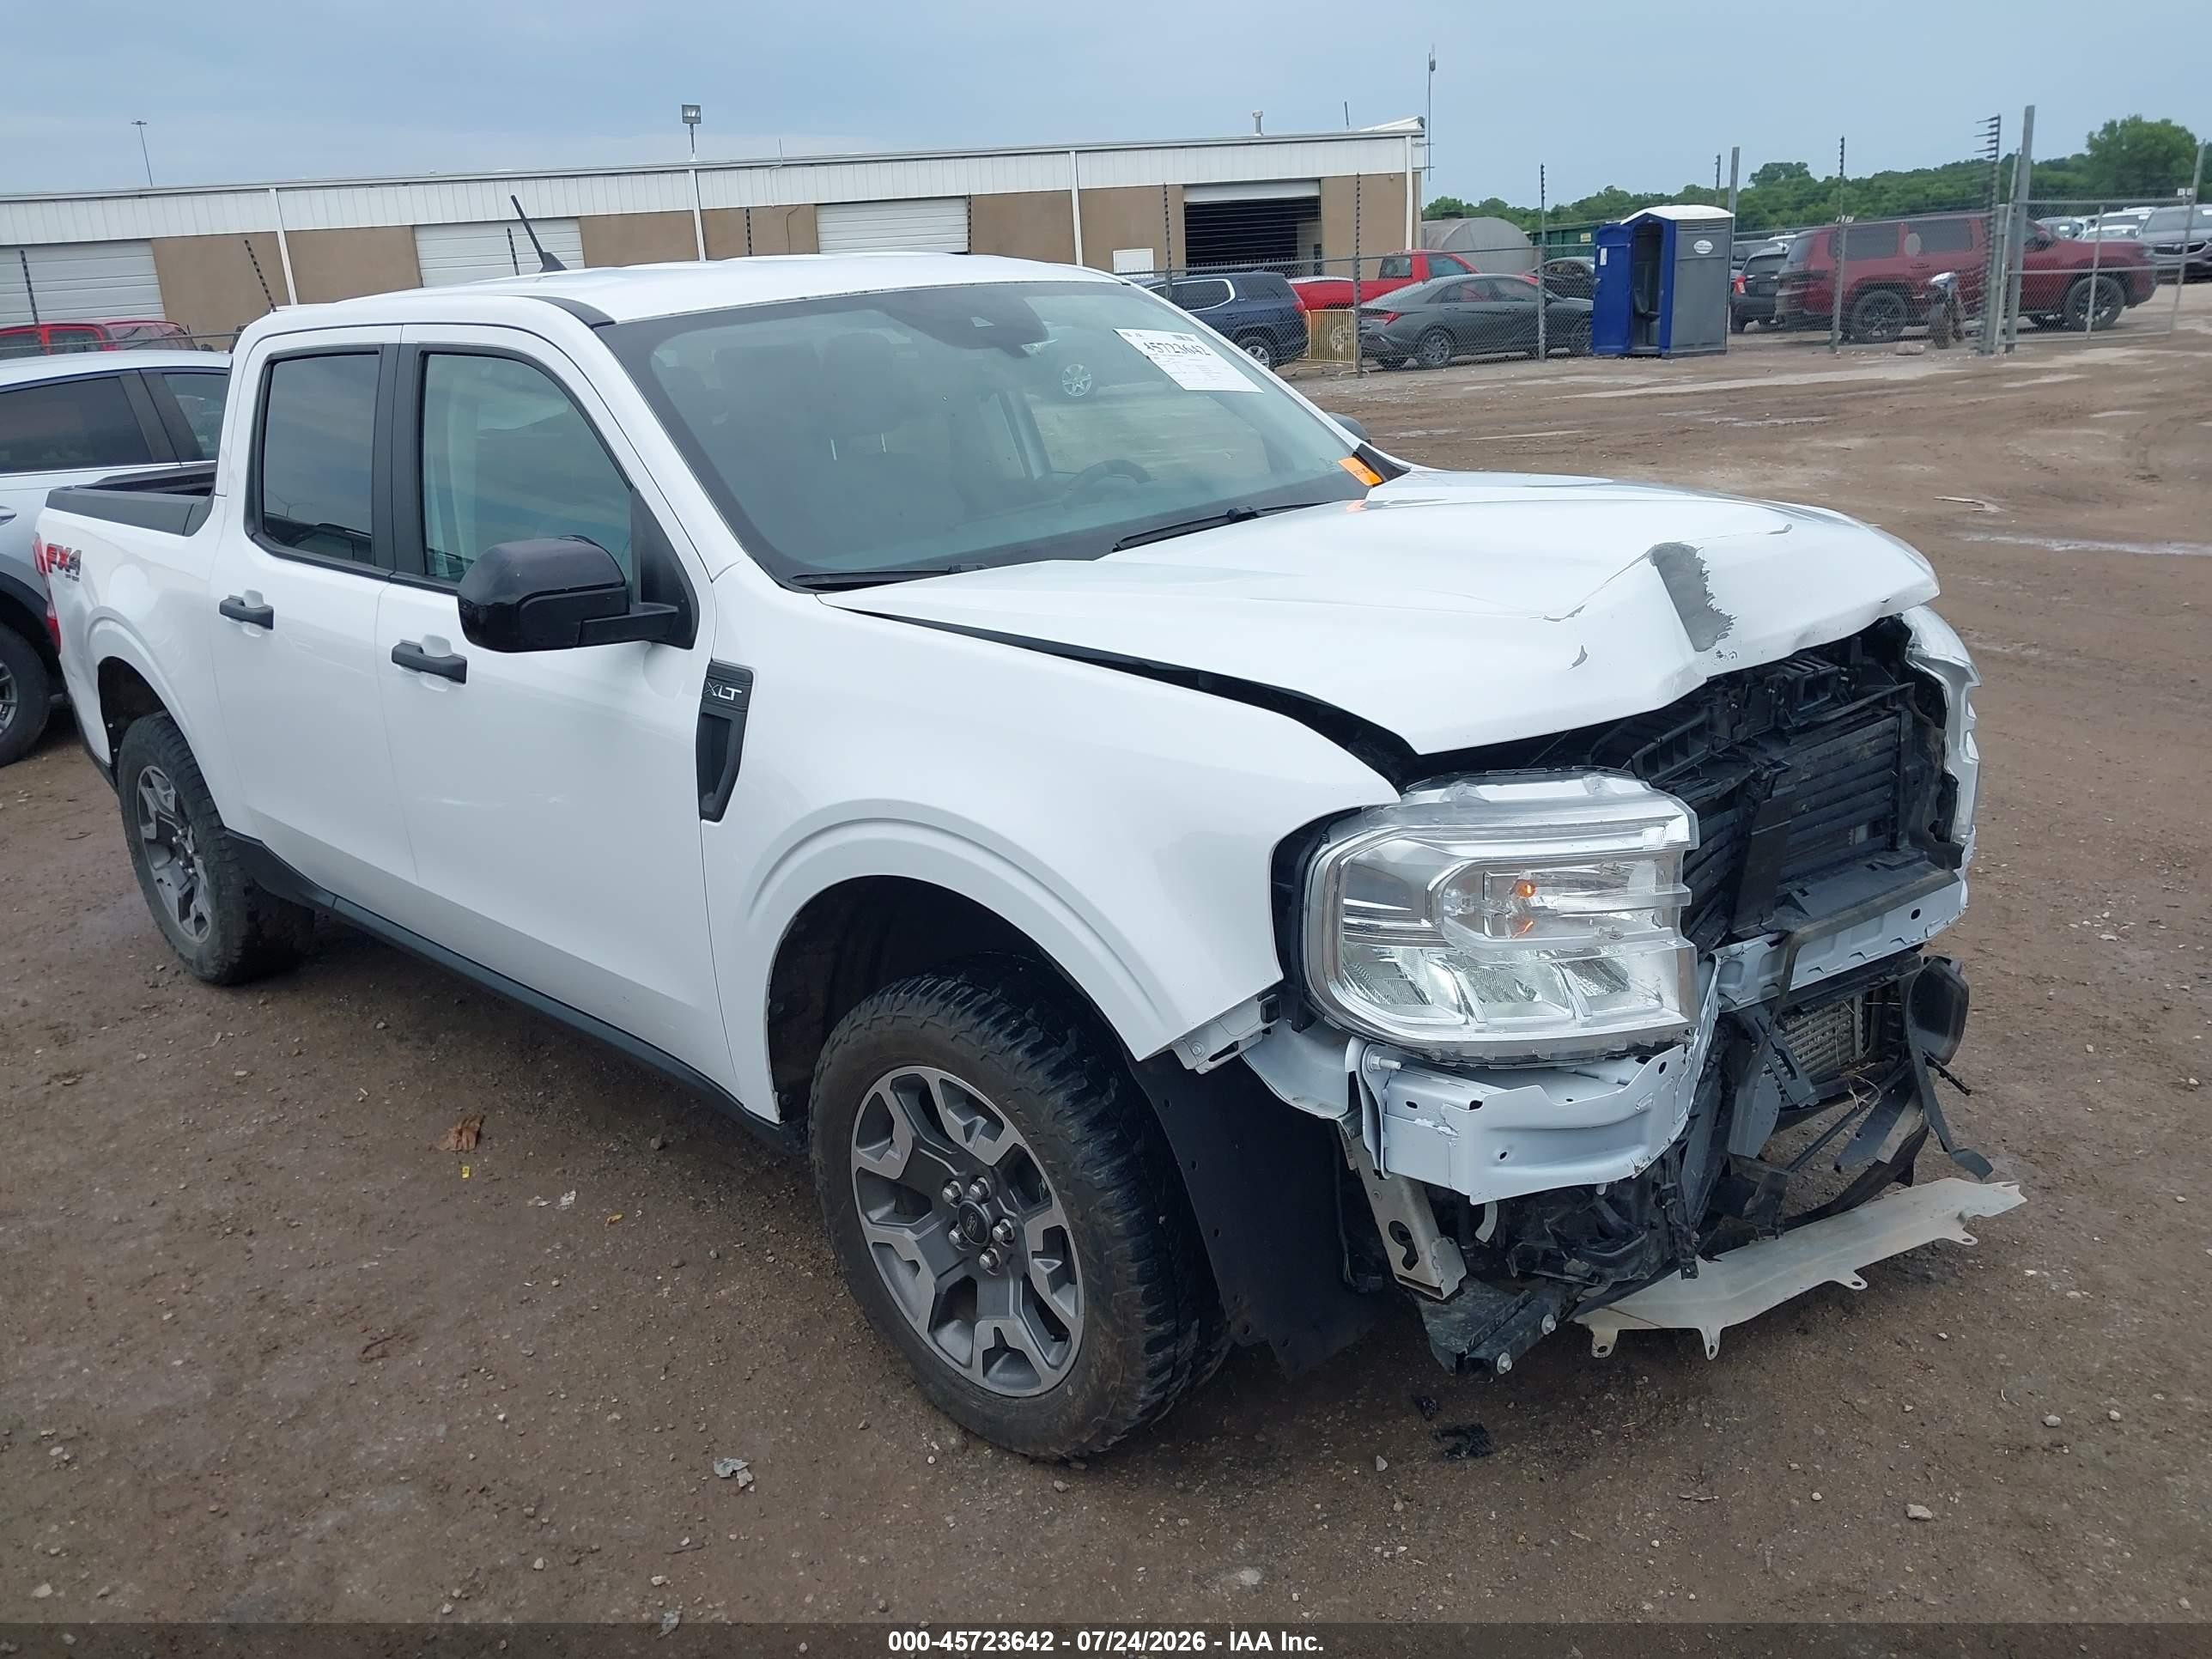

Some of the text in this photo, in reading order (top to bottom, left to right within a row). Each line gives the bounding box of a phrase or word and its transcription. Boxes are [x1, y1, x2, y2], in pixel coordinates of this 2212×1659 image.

[1143, 342, 1212, 356] 45723642
[46, 543, 82, 576] FX4
[703, 681, 742, 701] XLT
